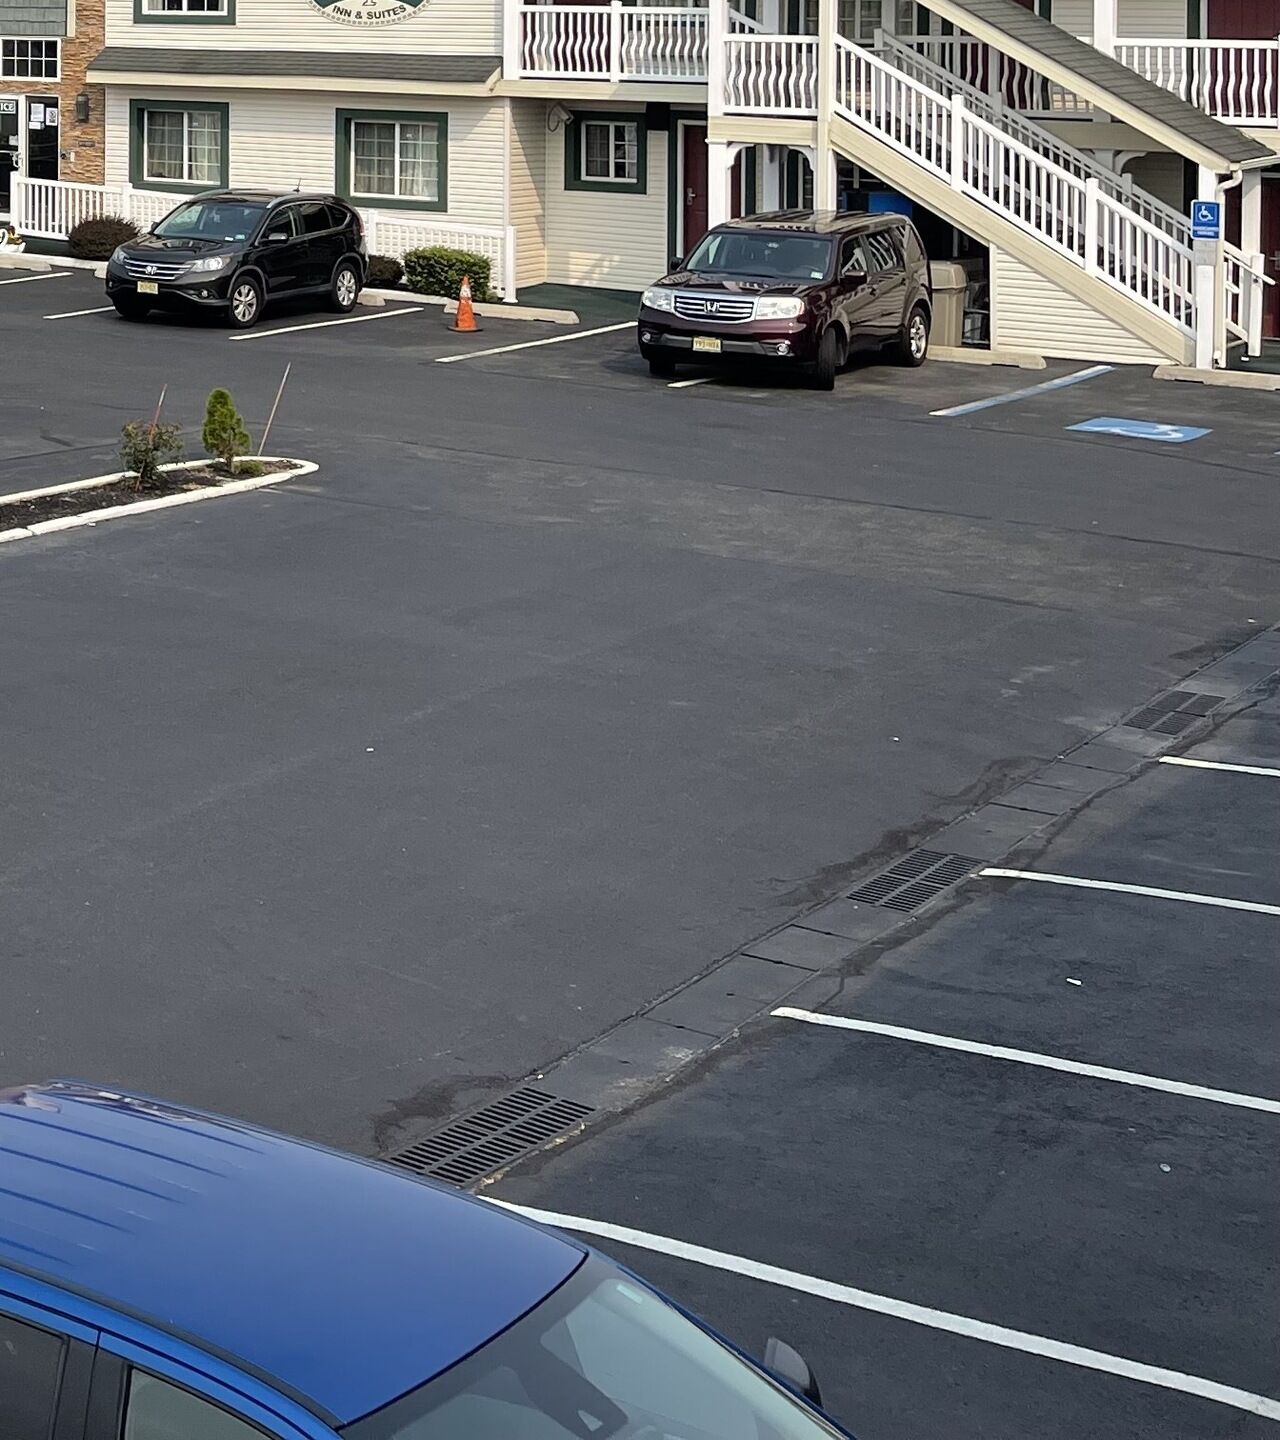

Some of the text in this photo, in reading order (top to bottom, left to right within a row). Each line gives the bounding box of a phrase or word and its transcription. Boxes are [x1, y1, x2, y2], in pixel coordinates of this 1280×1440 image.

[332, 4, 406, 20] INN & SUITES
